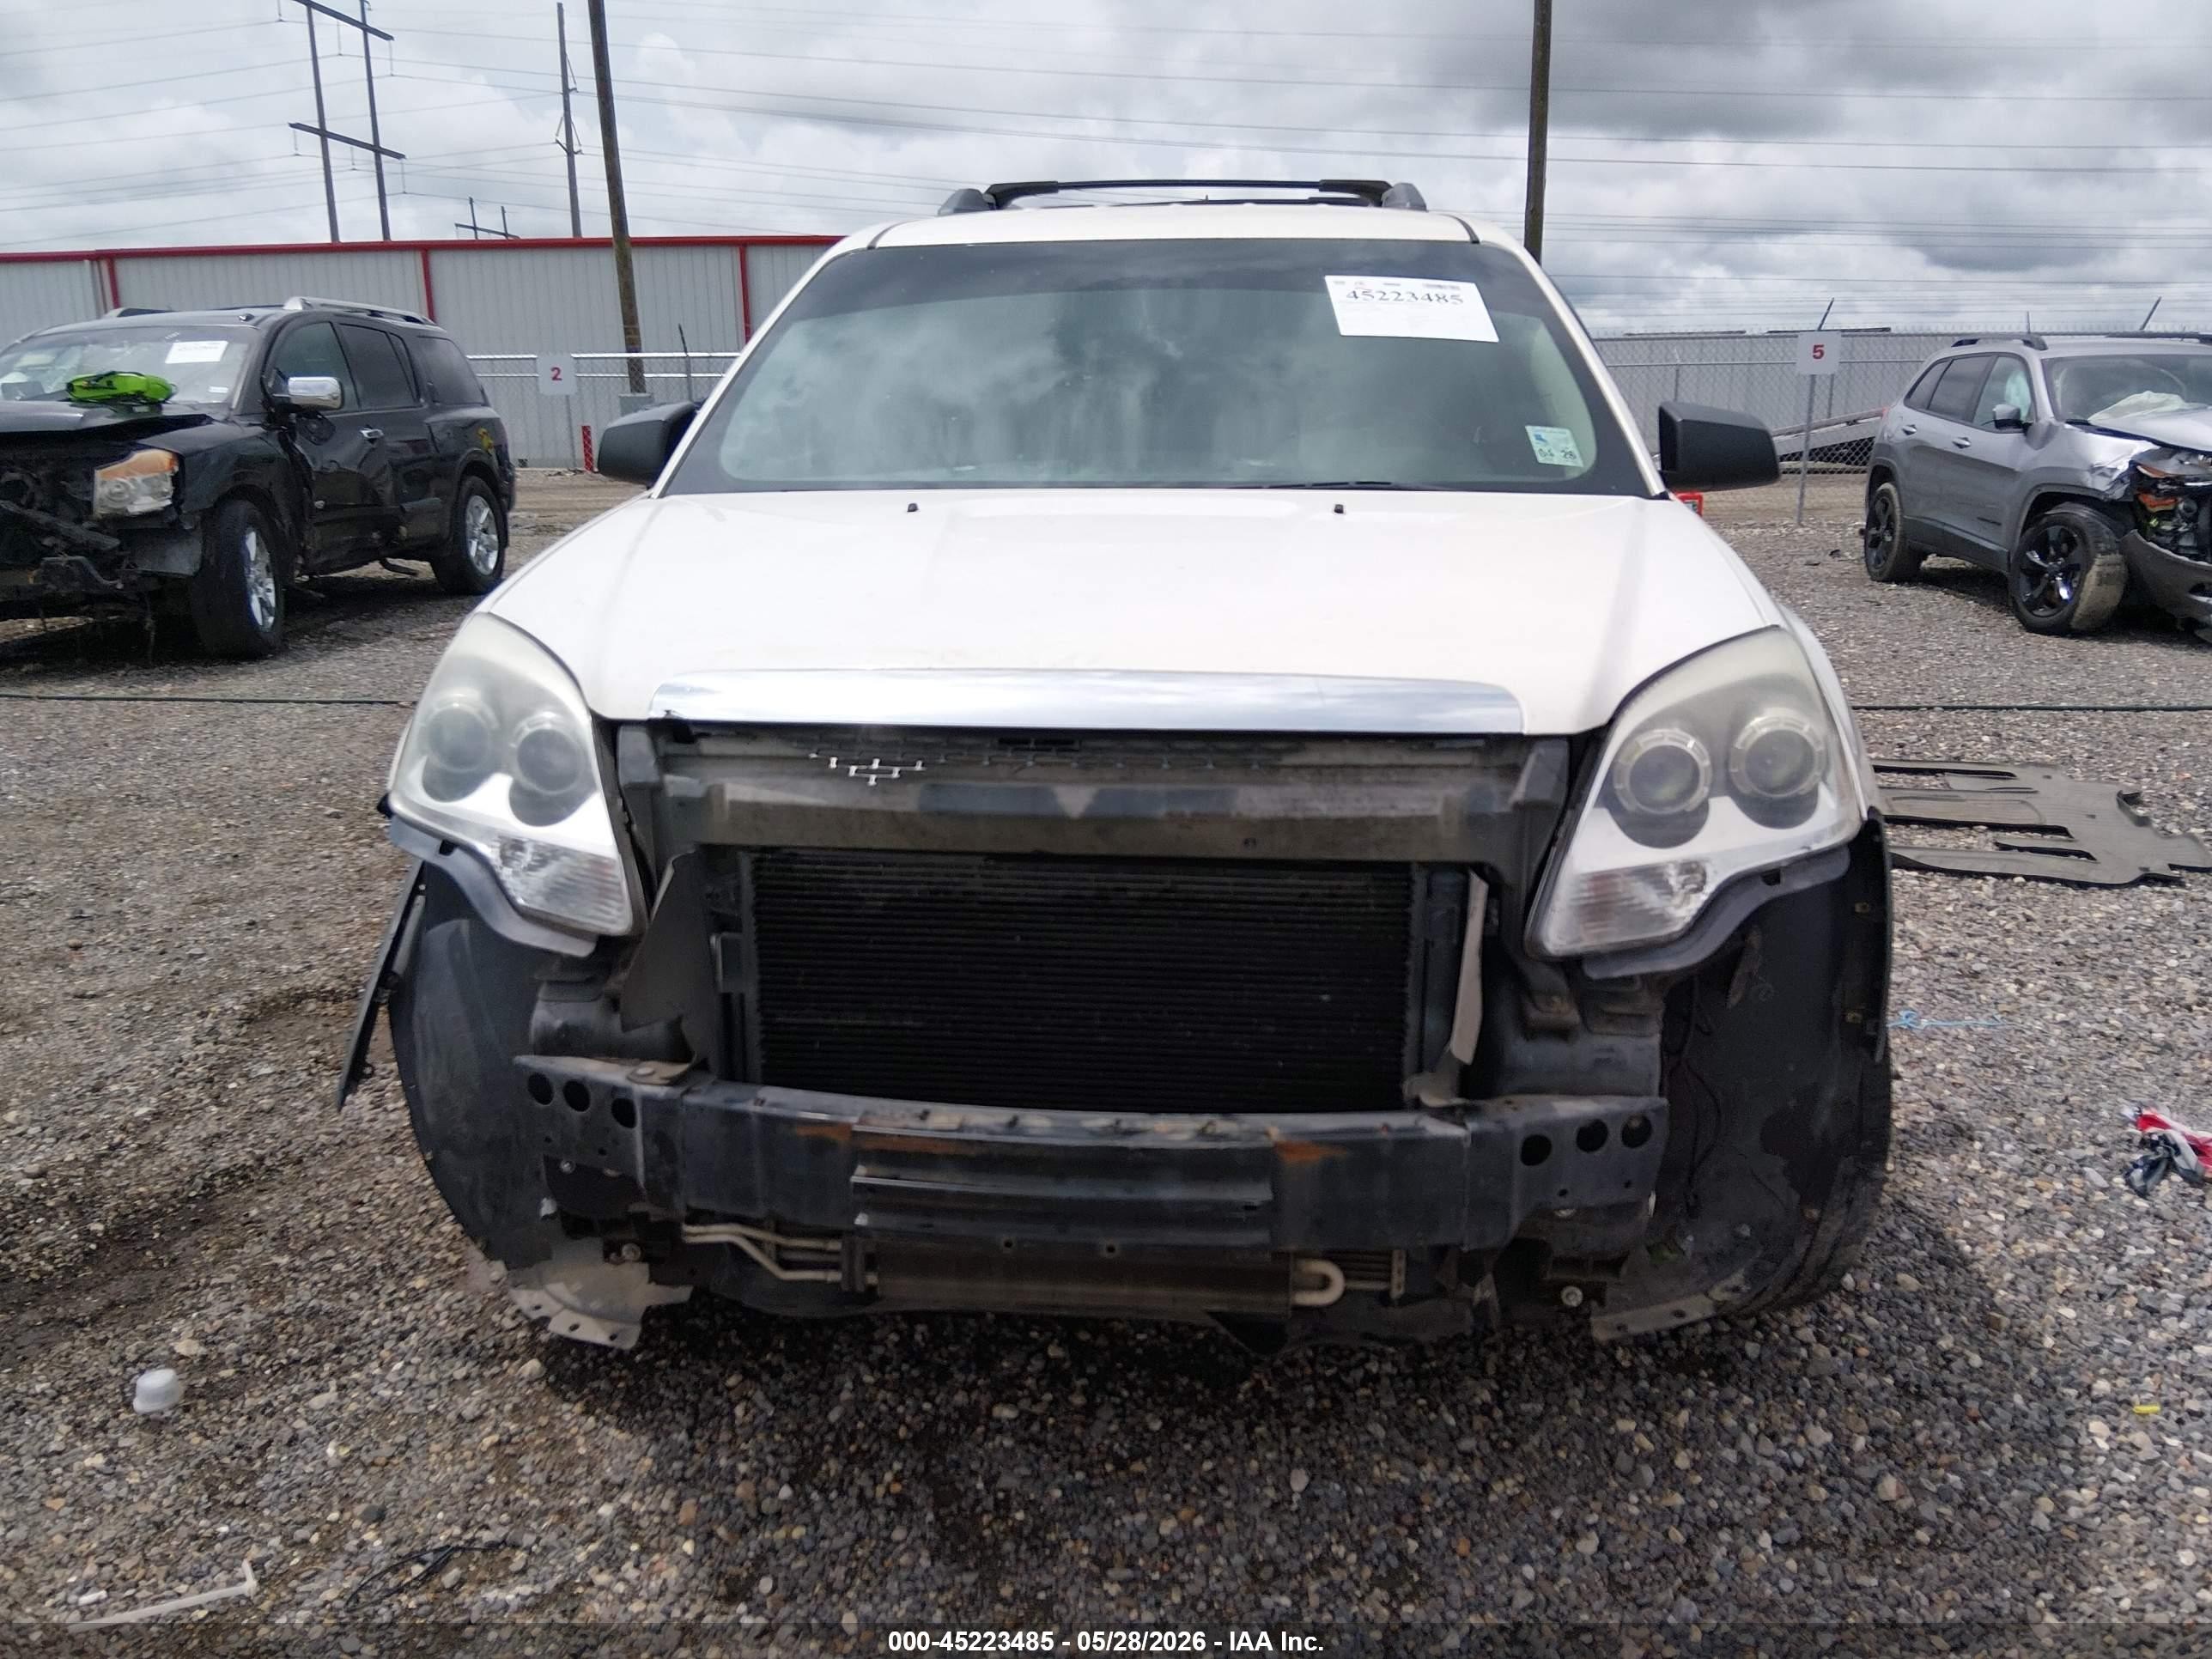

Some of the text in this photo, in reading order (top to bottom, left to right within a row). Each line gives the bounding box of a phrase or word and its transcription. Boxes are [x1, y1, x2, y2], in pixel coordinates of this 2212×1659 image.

[1346, 289, 1464, 305] 45223485
[1813, 344, 1825, 360] 5
[550, 367, 562, 381] 2
